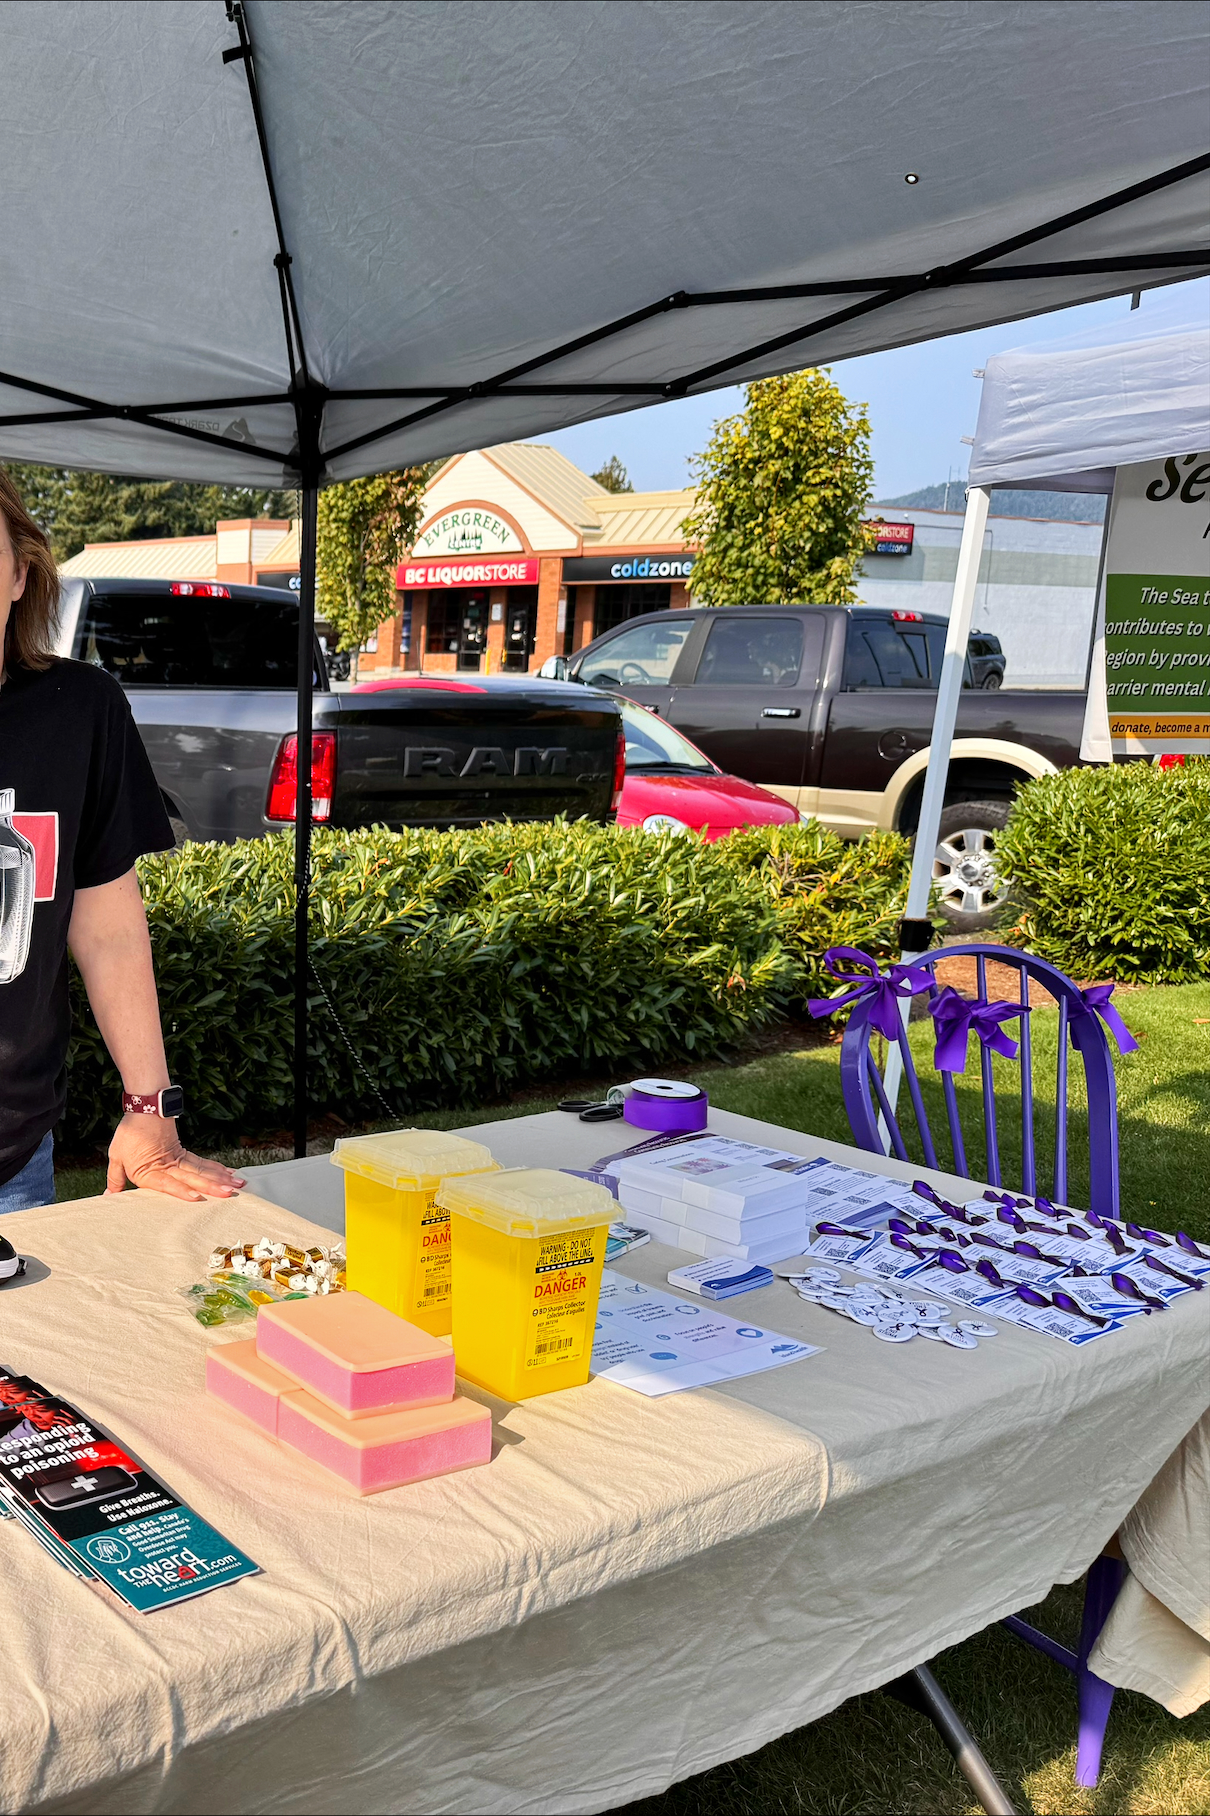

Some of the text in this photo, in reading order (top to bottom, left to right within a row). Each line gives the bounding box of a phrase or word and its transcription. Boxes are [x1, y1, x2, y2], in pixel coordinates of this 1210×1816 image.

[424, 512, 510, 547] EVERGREEN
[405, 568, 426, 584] BC
[611, 558, 693, 578] coldzone
[1141, 588, 1168, 604] The
[1170, 588, 1200, 605] Sea
[1105, 618, 1203, 636] ontributes to
[1105, 649, 1146, 670] egion
[1148, 649, 1170, 669] by
[1106, 679, 1206, 696] arrier mental
[1112, 722, 1152, 735] donate,
[1155, 723, 1192, 733] become
[1194, 725, 1200, 733] a
[403, 747, 568, 777] RAM
[423, 1232, 451, 1247] DAN
[541, 1242, 566, 1255] WARNING
[570, 1240, 579, 1250] DO
[580, 1238, 591, 1248] NOT
[538, 1248, 591, 1265] FILL ABOVE THE LINE
[534, 1276, 587, 1298] DANGER
[539, 1301, 586, 1315] BD Sharps Collector
[20, 1447, 43, 1460] an
[43, 1433, 96, 1454] opioid
[10, 1447, 100, 1480] poisoning
[99, 1492, 161, 1514] Give Breaths.
[107, 1498, 173, 1522] Use Naloxone.
[118, 1513, 179, 1535] Call 911. Stay
[126, 1518, 190, 1541] and help. Canada's
[132, 1525, 191, 1547] Good Samaritan Drug
[138, 1533, 187, 1552] Overdose Act may
[145, 1544, 179, 1559] protect you.
[116, 1547, 201, 1583] toward
[133, 1577, 153, 1588] THE
[162, 1562, 242, 1593] BCCDC HARM REDUCTION SERVICES
